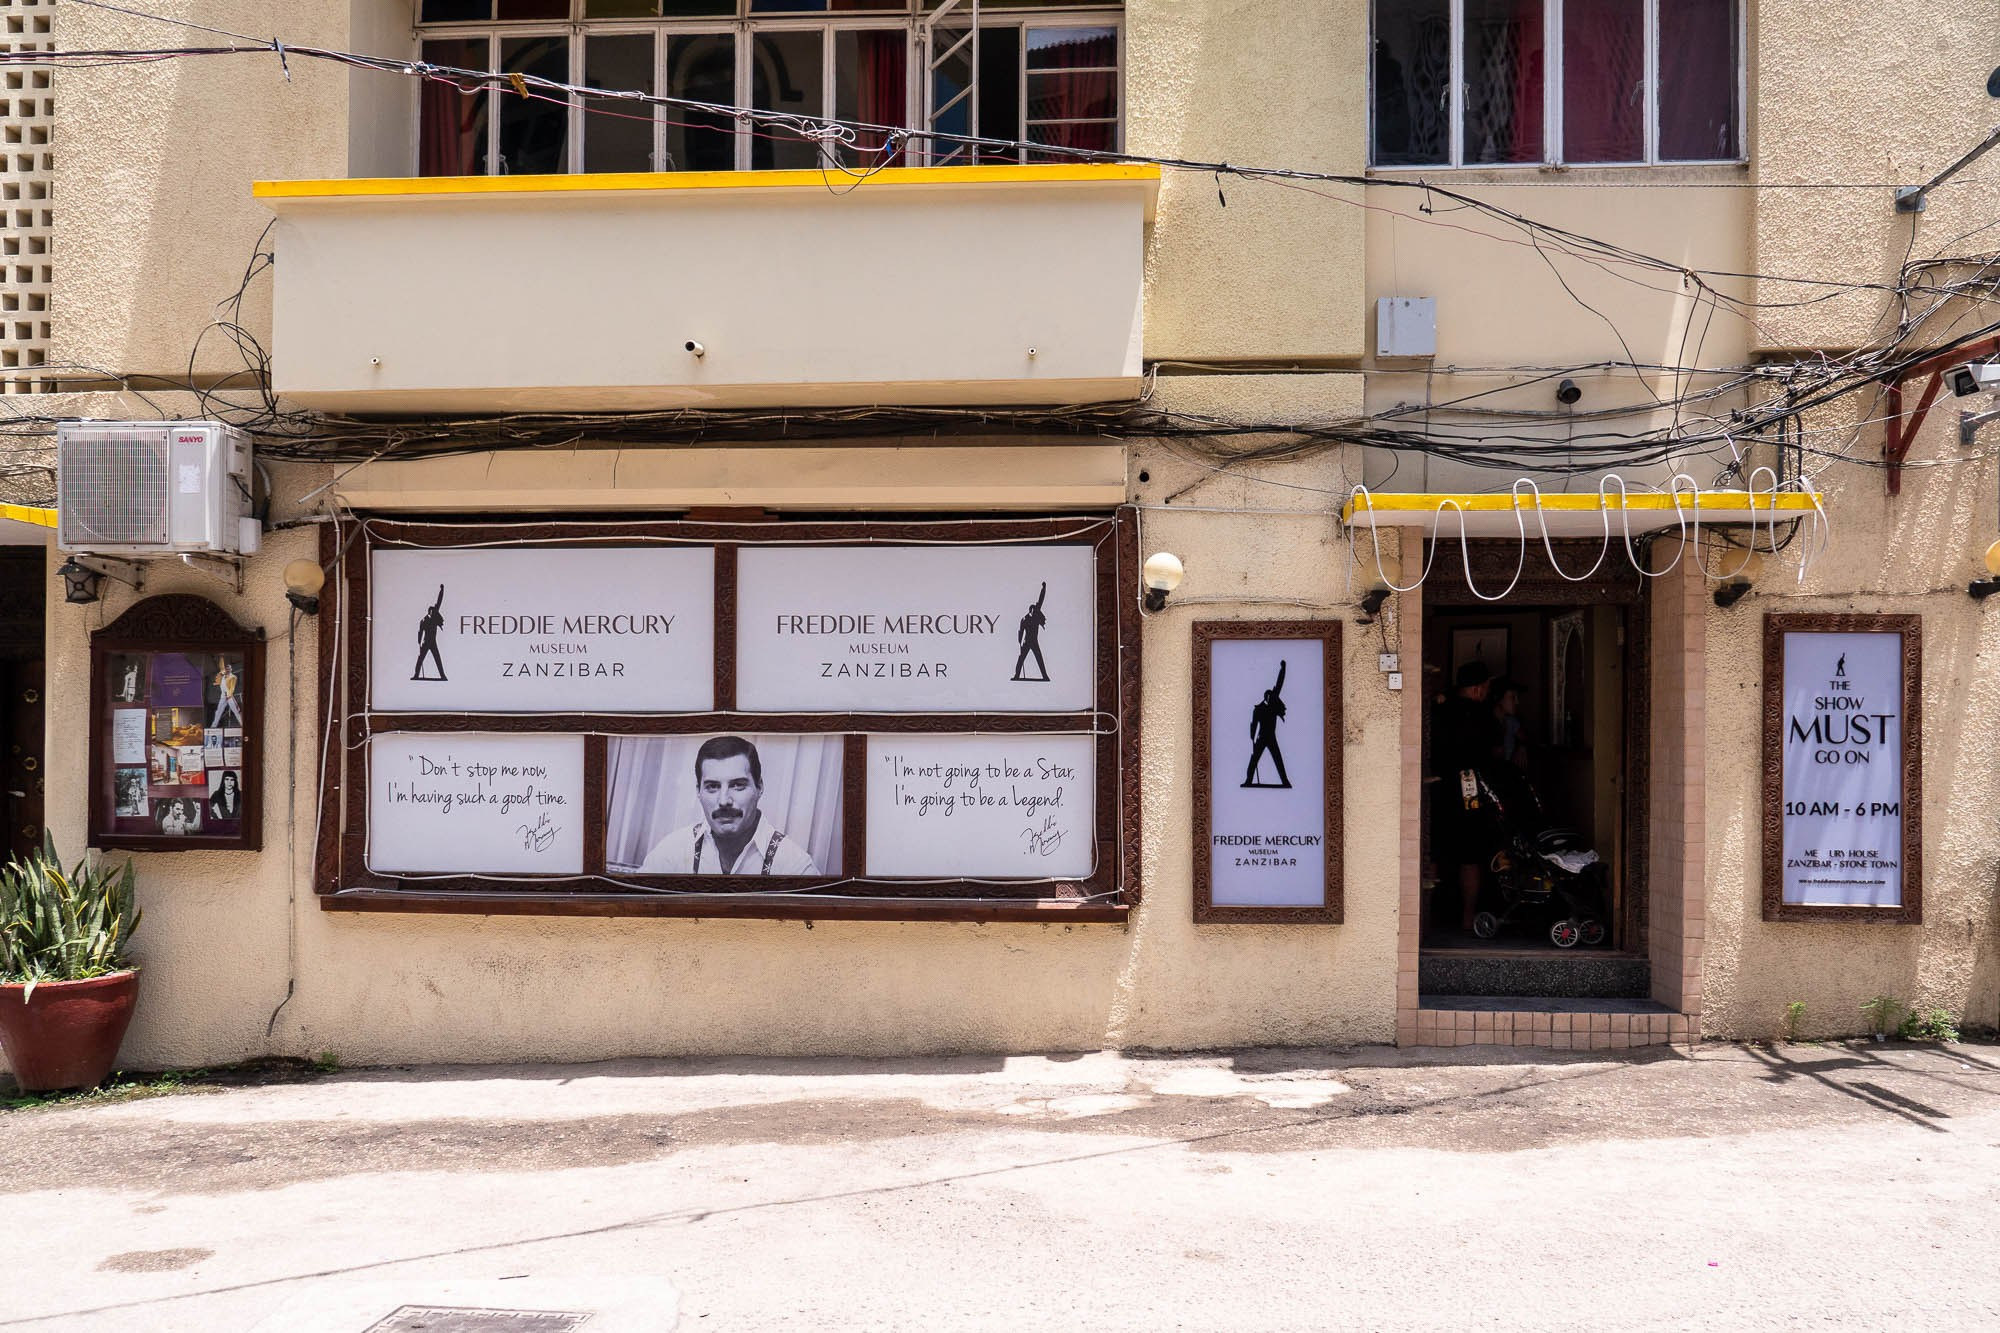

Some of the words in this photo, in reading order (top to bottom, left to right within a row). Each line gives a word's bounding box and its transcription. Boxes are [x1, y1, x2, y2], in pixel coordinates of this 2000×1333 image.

[460, 615, 555, 635] FREDDIE
[562, 615, 676, 635] MERCURY
[777, 615, 876, 635] FREDDIE
[883, 615, 1001, 635] MERCURY
[529, 643, 588, 655] MUSEUM
[848, 643, 909, 655] MUSEUM
[502, 662, 625, 678] ZANZIBAR
[821, 662, 948, 678] ZANZIBAR
[1829, 680, 1851, 691] THE
[1815, 697, 1865, 711] SHOW
[1789, 714, 1896, 745] MUST
[1815, 750, 1841, 765] GO
[1844, 750, 1870, 765] ON
[467, 762, 497, 786] stop
[501, 766, 519, 777] me
[522, 765, 548, 780] now,
[918, 763, 943, 778] not
[945, 764, 981, 788] going
[987, 764, 1001, 778] to
[1004, 758, 1020, 778] be
[1023, 768, 1034, 778] a
[1037, 757, 1076, 781] Star,
[388, 782, 408, 803] I'm
[411, 782, 454, 814] having
[457, 782, 486, 805] such
[489, 795, 499, 804] a
[501, 785, 533, 814] good
[536, 791, 567, 805] time.
[895, 784, 917, 805] I'm
[918, 792, 955, 817] going
[960, 792, 976, 806] to
[979, 786, 995, 806] be
[998, 796, 1008, 806] a
[1785, 802, 1806, 817] 10
[1809, 802, 1840, 817] AM
[1855, 802, 1866, 817] 6
[1871, 803, 1899, 817] PM
[1213, 835, 1262, 846] FREDDIE
[1265, 835, 1322, 846] MERCURY
[1804, 849, 1846, 858] MEURY
[1849, 849, 1879, 858] HOUSE
[1235, 858, 1297, 867] ZANZIBAR
[1786, 859, 1832, 868] ZANZIBAR
[1839, 860, 1868, 869] STONE
[1870, 860, 1898, 869] TOWN
